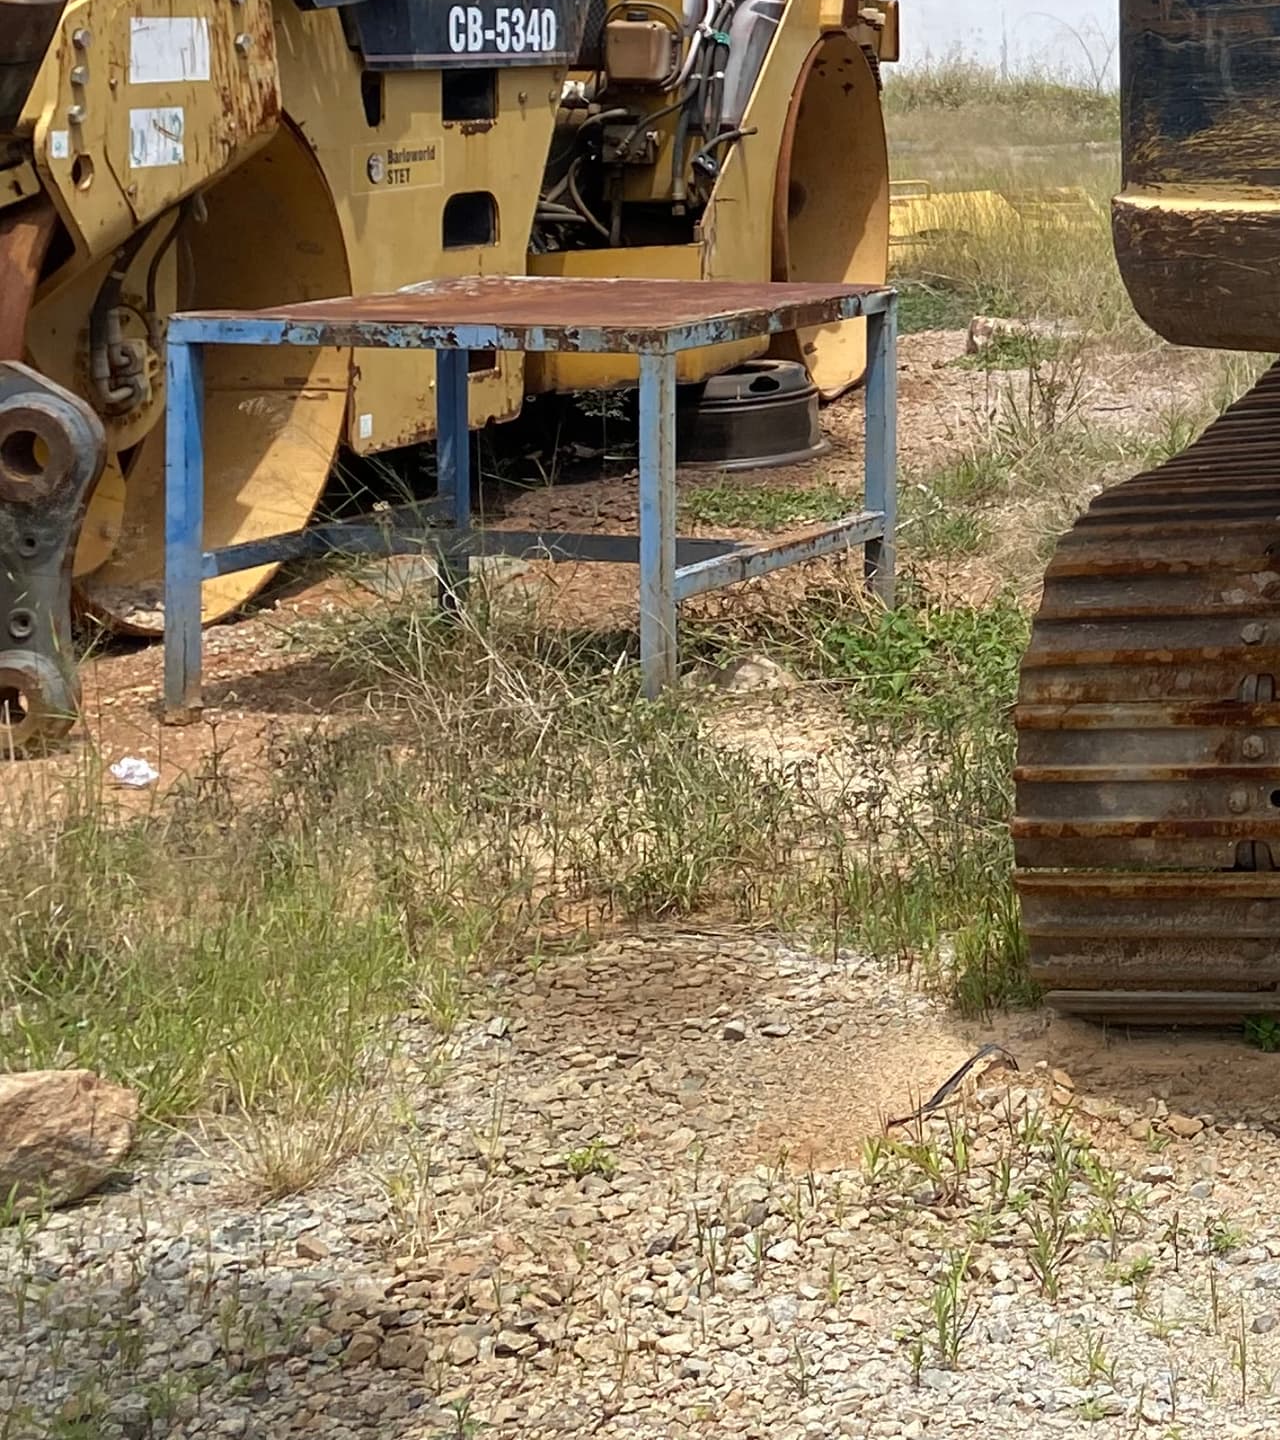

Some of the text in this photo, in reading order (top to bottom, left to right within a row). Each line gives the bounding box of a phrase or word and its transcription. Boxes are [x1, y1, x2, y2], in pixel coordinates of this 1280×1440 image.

[449, 6, 557, 53] CB-534D
[387, 144, 436, 165] Barloworld
[387, 167, 411, 185] STET
